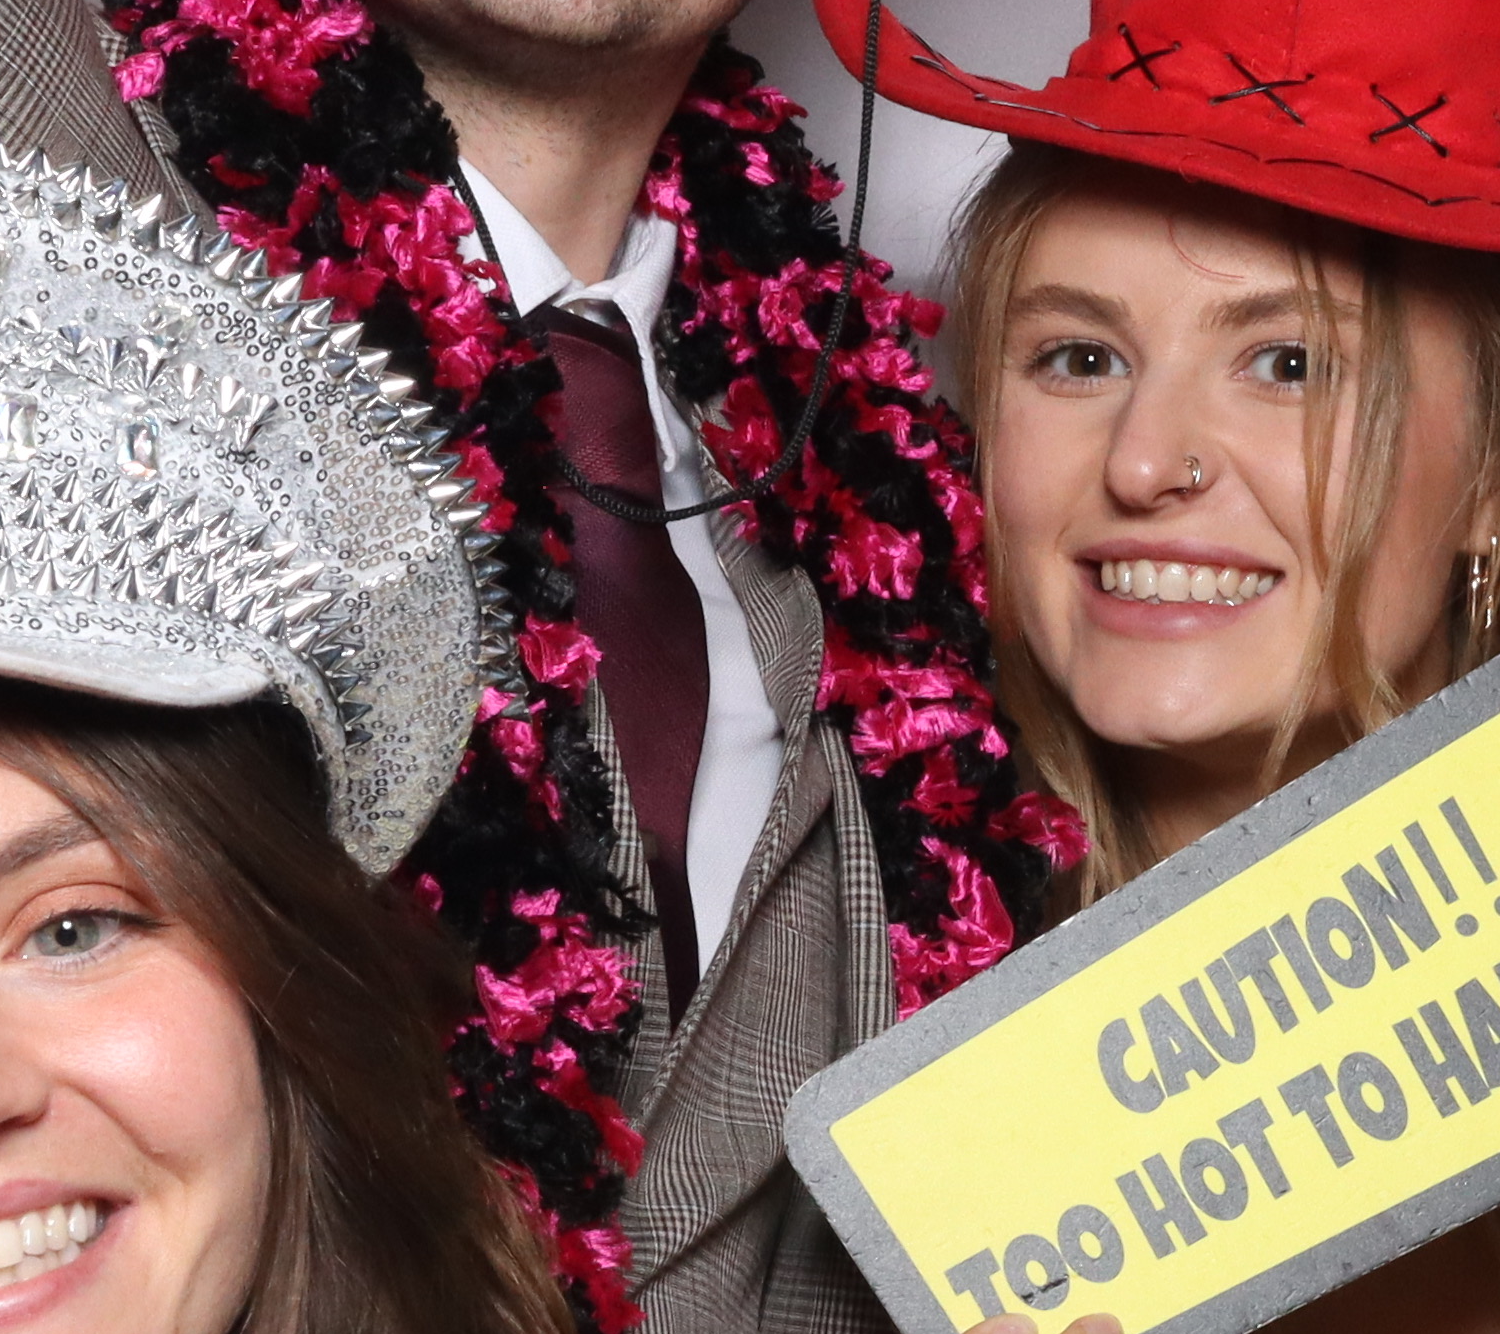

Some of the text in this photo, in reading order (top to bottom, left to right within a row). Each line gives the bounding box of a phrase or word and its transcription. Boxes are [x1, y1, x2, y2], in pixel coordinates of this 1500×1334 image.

[943, 1204, 1125, 1322] TOO
[1115, 1098, 1292, 1259] HOT
[1277, 1051, 1409, 1168] TO
